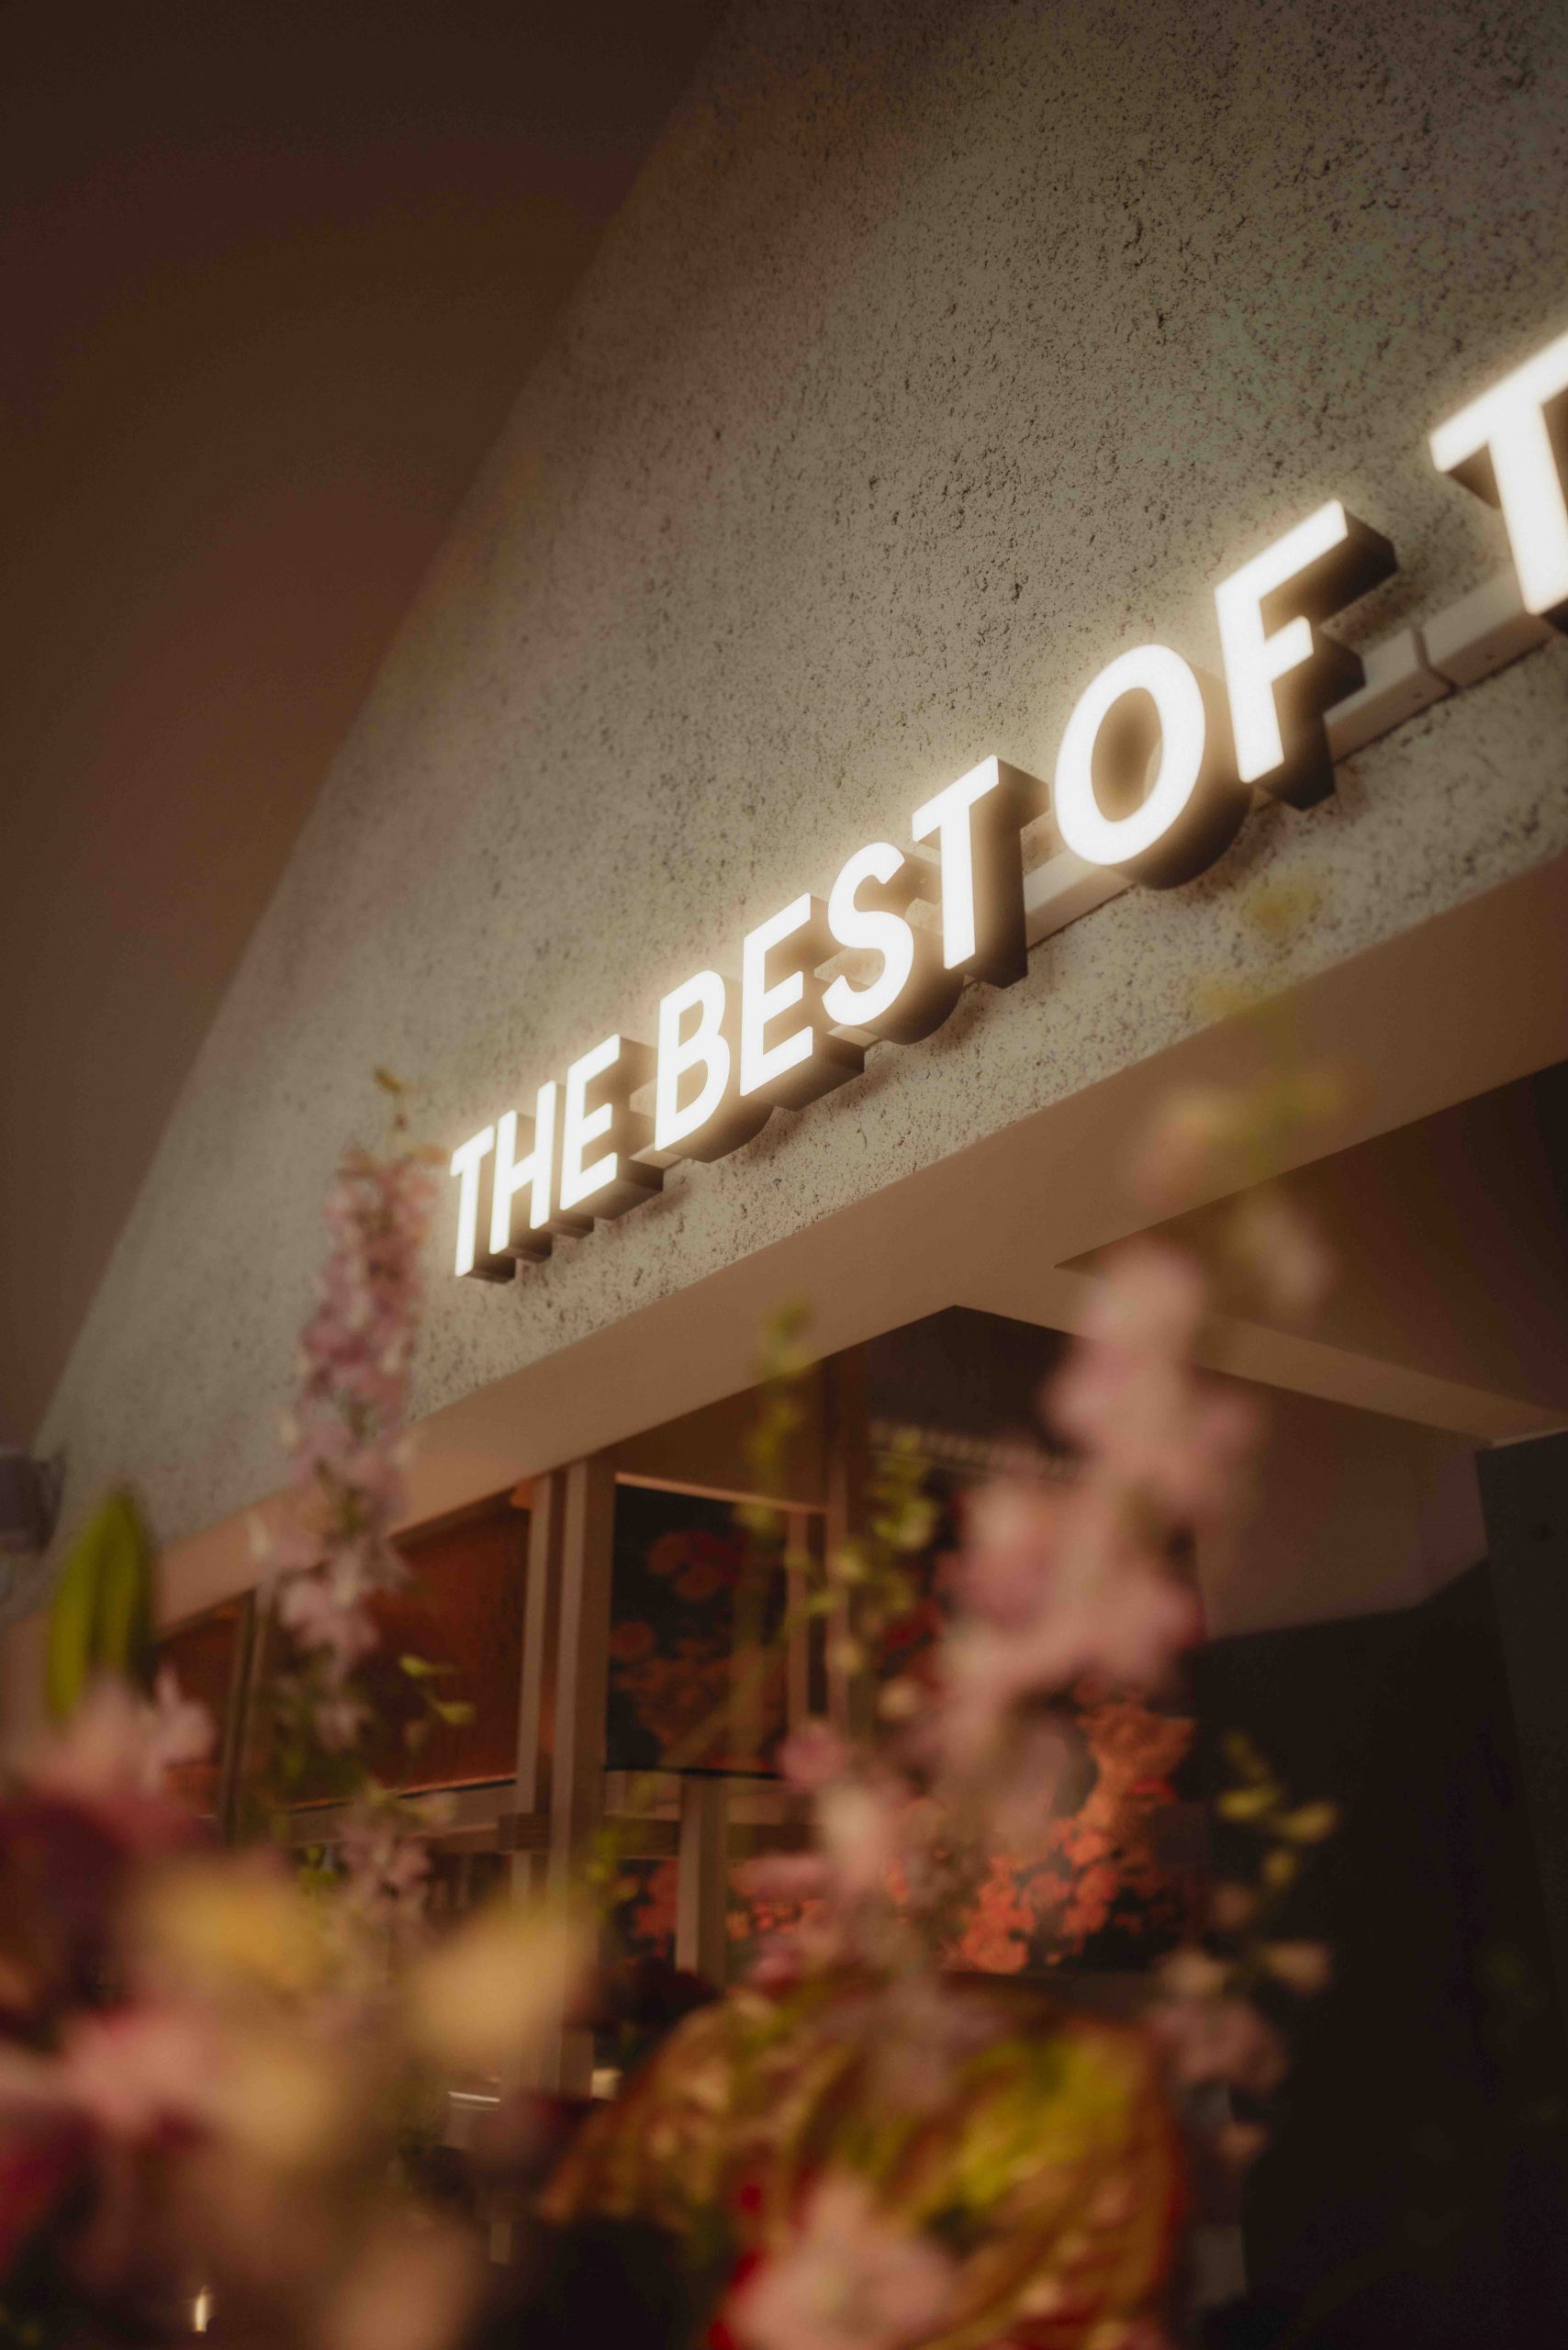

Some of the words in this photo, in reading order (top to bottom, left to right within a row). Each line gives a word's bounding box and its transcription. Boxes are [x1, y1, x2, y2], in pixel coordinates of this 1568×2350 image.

[450, 1034, 622, 1277] THE
[655, 755, 1000, 1152] BEST
[1053, 498, 1349, 867] OF
